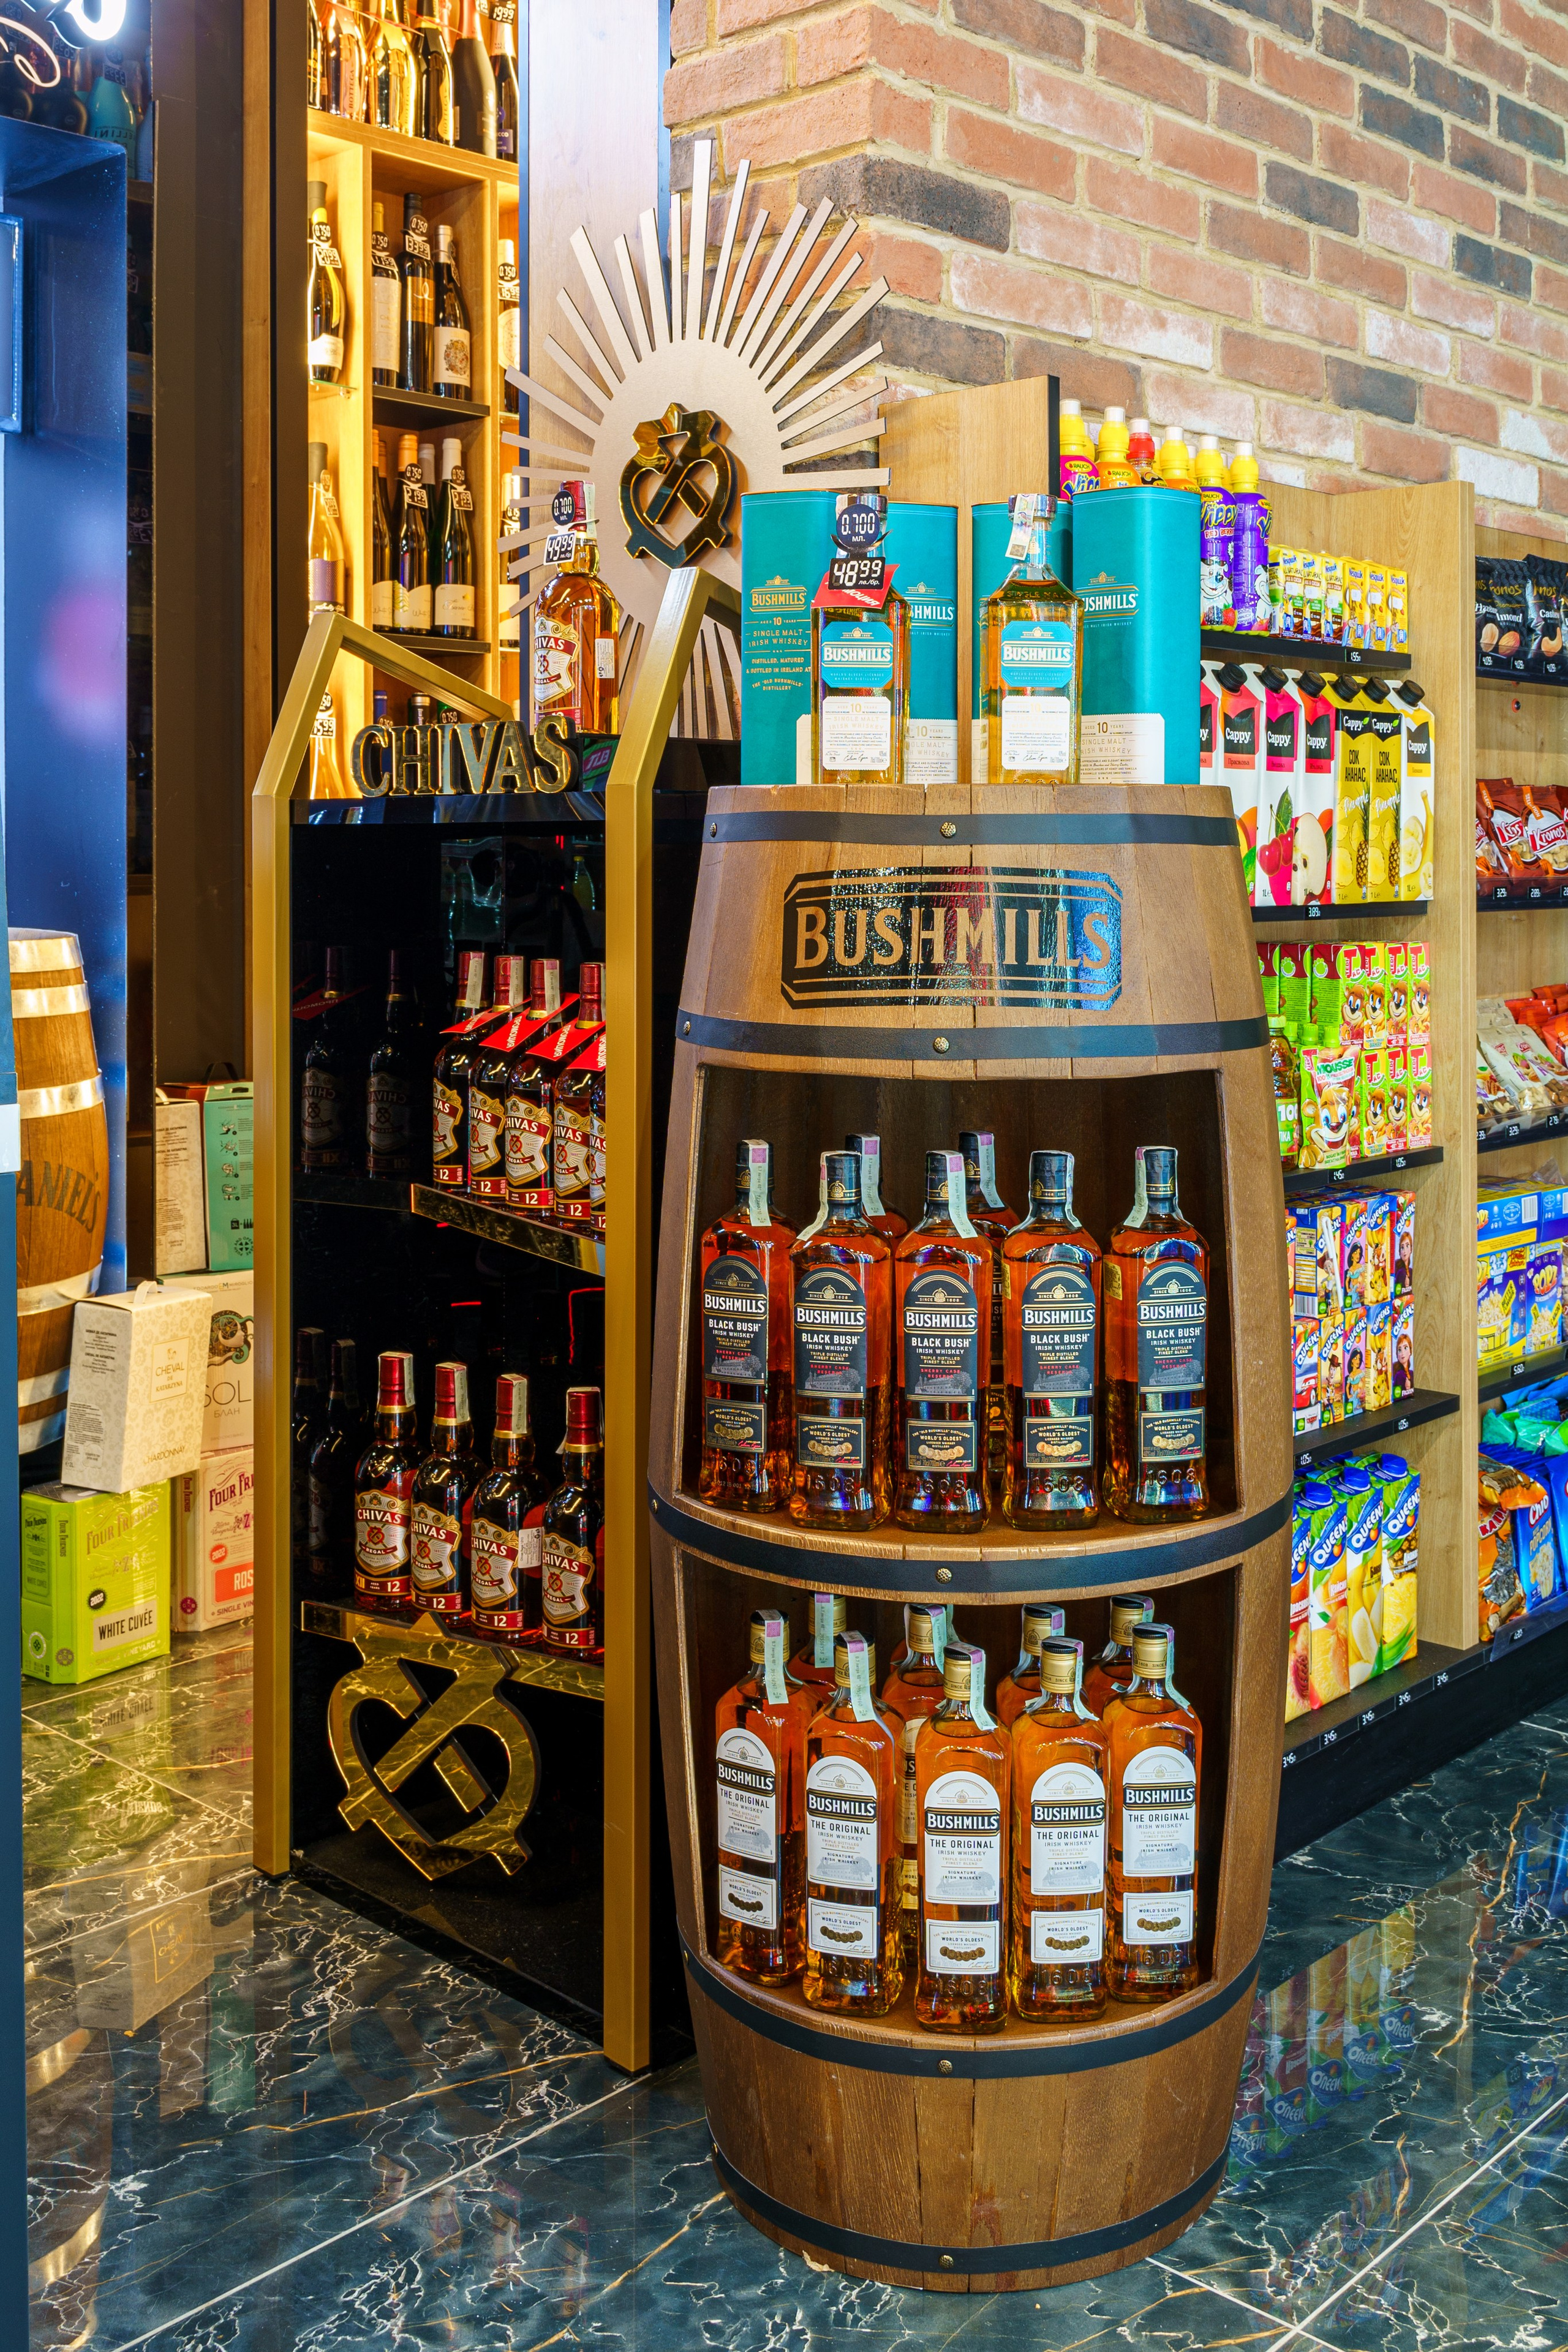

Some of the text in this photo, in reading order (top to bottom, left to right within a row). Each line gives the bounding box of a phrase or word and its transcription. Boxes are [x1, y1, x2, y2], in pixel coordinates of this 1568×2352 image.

[554, 497, 572, 516] 0.700
[842, 513, 875, 535] 0.700
[752, 592, 804, 606] BUSHMILLS
[1084, 594, 1136, 611] USHMILLS
[535, 638, 565, 650] HIVAS
[823, 647, 891, 662] BUSHMILLS
[1003, 646, 1071, 662] BUSHMILLS
[851, 703, 861, 712] 10
[1097, 722, 1107, 733] 10
[1373, 718, 1393, 733] Cappy
[1226, 727, 1251, 743] Cappy
[1267, 731, 1291, 746] Cappy
[1306, 734, 1327, 748] Cappy
[1408, 739, 1428, 753] Cappy
[350, 715, 578, 797] CHIVAS
[1349, 749, 1359, 766] СОК
[1379, 752, 1390, 766] СОК
[1345, 767, 1366, 783] АНАНАС
[1376, 768, 1397, 783] АНАНАС
[794, 906, 1110, 970] BUSHMILLS
[1317, 1058, 1354, 1075] MOUSSE
[17, 1159, 102, 1234] ANIEL'S
[526, 1193, 538, 1204] 12
[570, 1204, 582, 1216] 12
[1532, 1265, 1558, 1295] POPZ
[705, 1294, 764, 1313] BUSHMILLS
[1140, 1303, 1205, 1319] BUSHMILLS
[797, 1308, 864, 1325] BUSHMILLS
[907, 1312, 975, 1328] BUSHMILLS
[1025, 1309, 1093, 1325] BUSHMILLS
[709, 1319, 759, 1332] BLACK BUSH
[1147, 1327, 1200, 1339] BLACK BUSH
[802, 1333, 858, 1345] BLACK BUSH
[911, 1338, 969, 1348] BLACK BUSH
[1031, 1333, 1087, 1344] BLACK BUSH
[156, 1362, 184, 1377] CHEVAL
[156, 1381, 183, 1392] KATARZYNA
[143, 1445, 186, 1465] CHARDONNAY
[209, 1482, 237, 1513] FOUR
[358, 1509, 402, 1524] CHIVAS
[1529, 1495, 1548, 1525] Chio
[212, 1547, 225, 1561] 2022
[234, 1569, 253, 1591] ROS
[387, 1581, 400, 1592] 12
[90, 1593, 104, 1607] 2022
[433, 1598, 445, 1608] 12
[217, 1603, 241, 1616] SINGLE
[99, 1608, 153, 1640] WHITE CUVÉE
[494, 1615, 507, 1626] 12
[565, 1633, 579, 1644] 12
[123, 1640, 156, 1657] VINEYARD
[718, 1764, 772, 1790] BUSHMILLS
[720, 1788, 770, 1809] THE ORIGINAL
[1126, 1788, 1193, 1804] BUSHMILLS
[809, 1796, 874, 1816] BUSHMILLS
[1035, 1805, 1102, 1821] BUSHMILLS
[927, 1814, 998, 1830] BUSHMILLS
[1128, 1812, 1189, 1823] THE ORIGINAL
[811, 1819, 871, 1834] THE ORIGINAL
[1037, 1830, 1099, 1840] THE ORIGINAL
[930, 1839, 994, 1849] THE ORIGINAL
